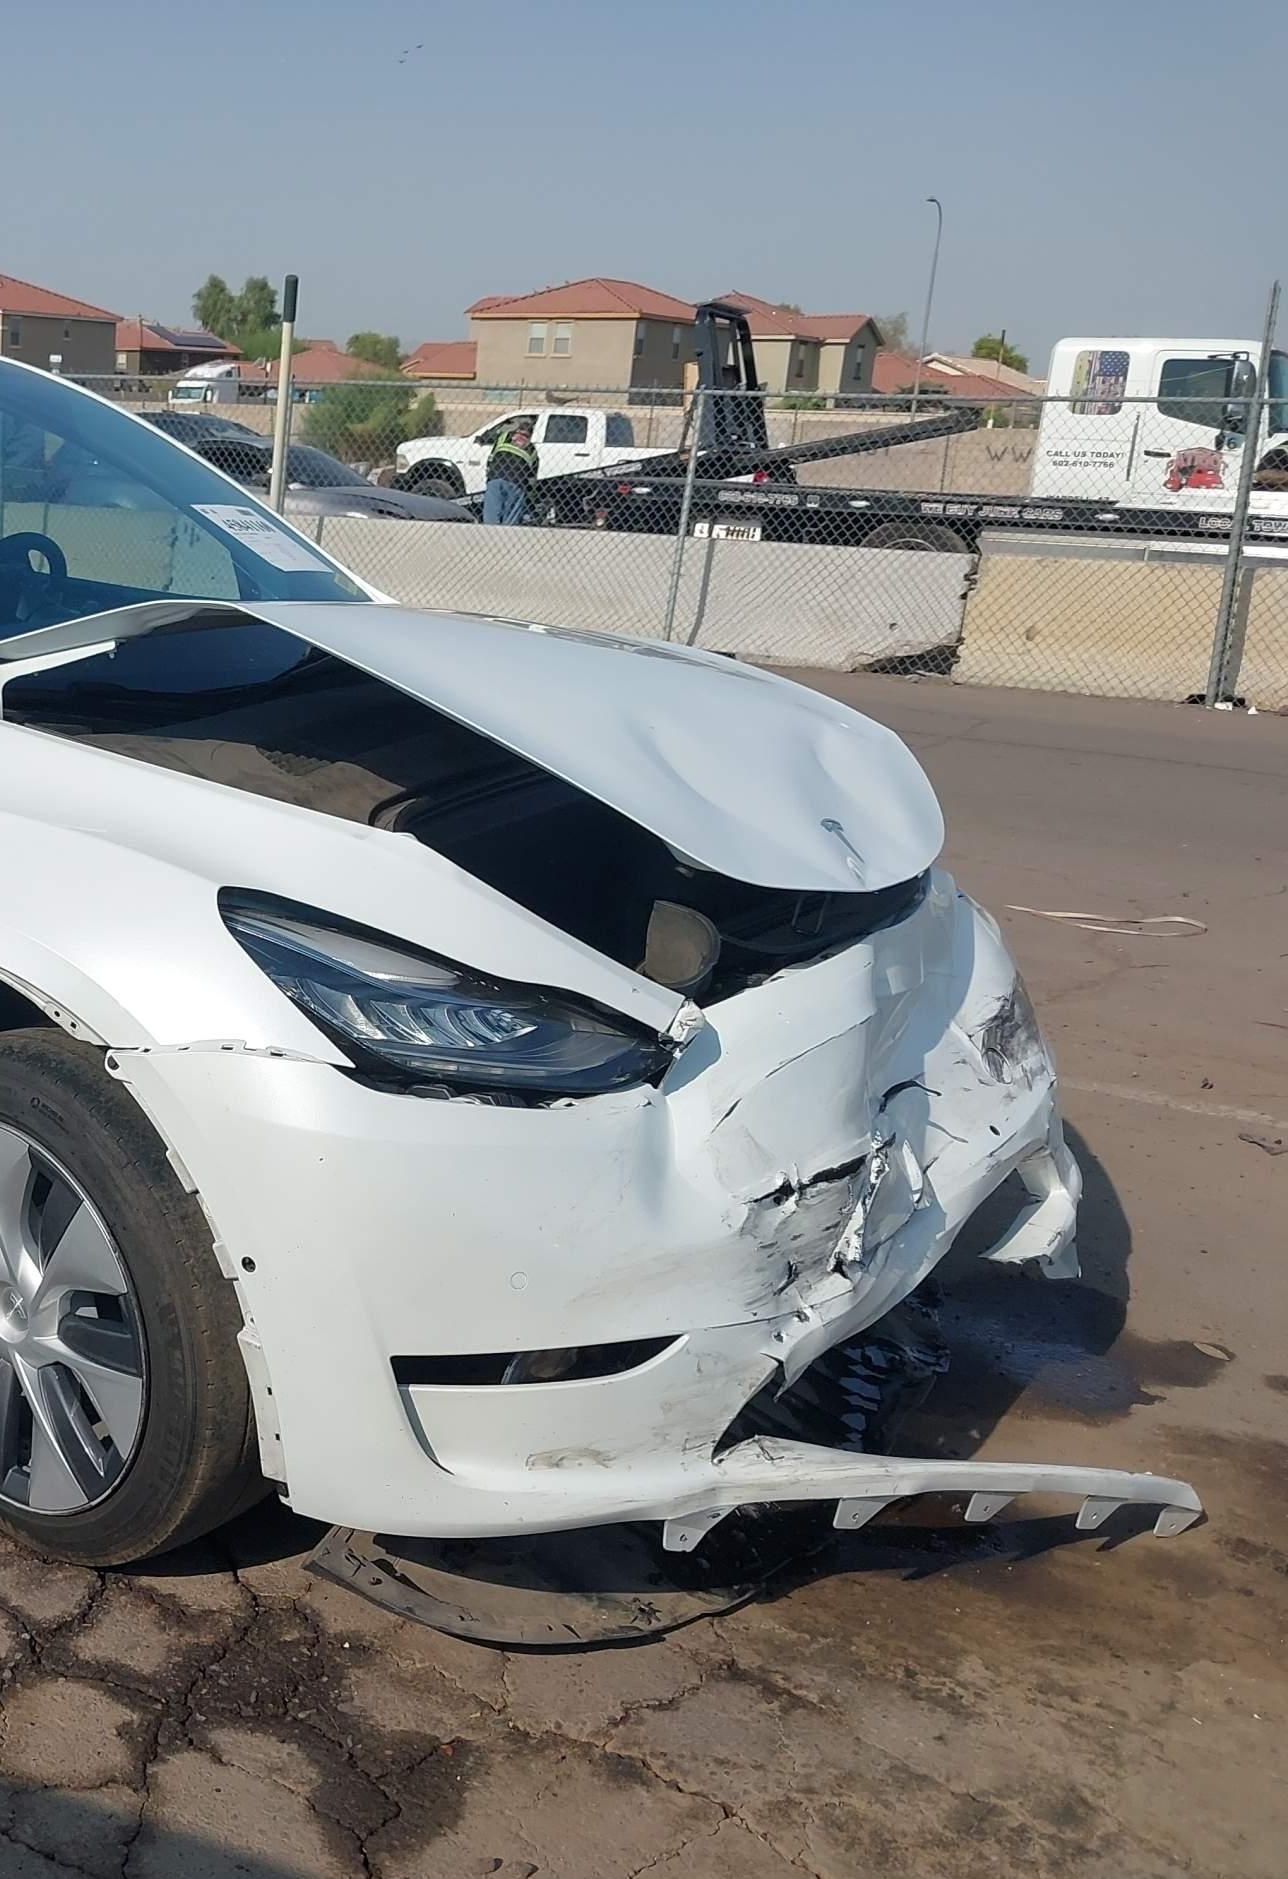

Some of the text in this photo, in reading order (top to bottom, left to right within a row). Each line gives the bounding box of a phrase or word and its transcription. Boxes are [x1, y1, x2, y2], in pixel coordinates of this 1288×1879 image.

[1046, 450, 1071, 458] CALL
[1073, 450, 1087, 458] US
[1022, 507, 1063, 521] CARS
